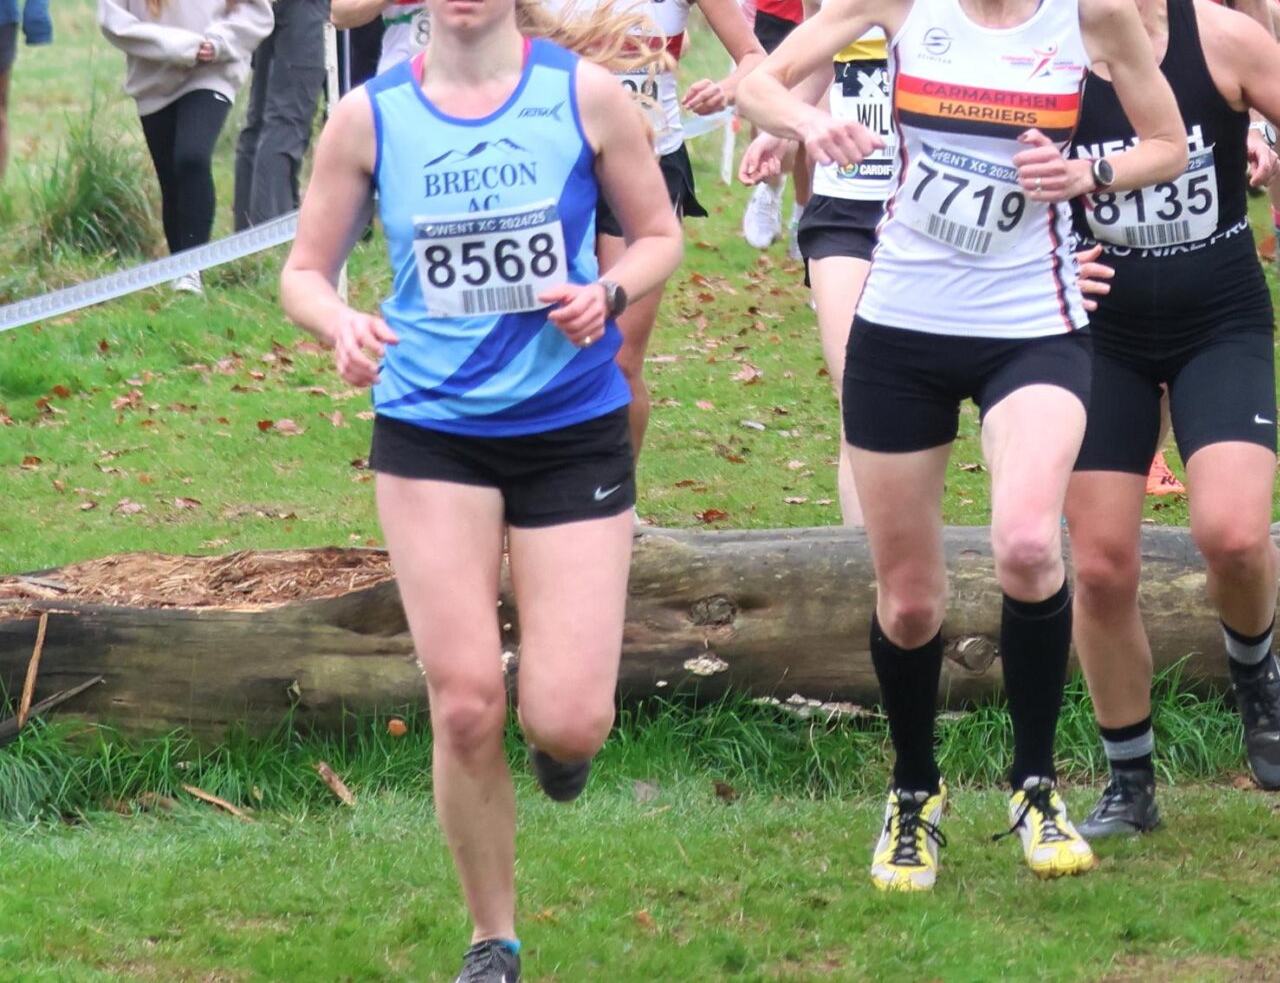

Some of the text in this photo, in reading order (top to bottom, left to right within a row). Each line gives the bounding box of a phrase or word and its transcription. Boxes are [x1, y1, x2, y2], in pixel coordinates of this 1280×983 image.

[922, 81, 1058, 109] CARMARTHEN
[857, 104, 895, 135] WIL
[938, 101, 1039, 125] HARRIERS
[423, 161, 538, 198] BRECON
[970, 162, 987, 173] XC
[989, 166, 1019, 181] 2024/
[468, 194, 501, 213] AC
[912, 160, 1026, 233] 7719
[1091, 175, 1213, 226] 8135
[426, 213, 546, 237] GWENT XC 2024/25
[424, 232, 558, 289] 8568
